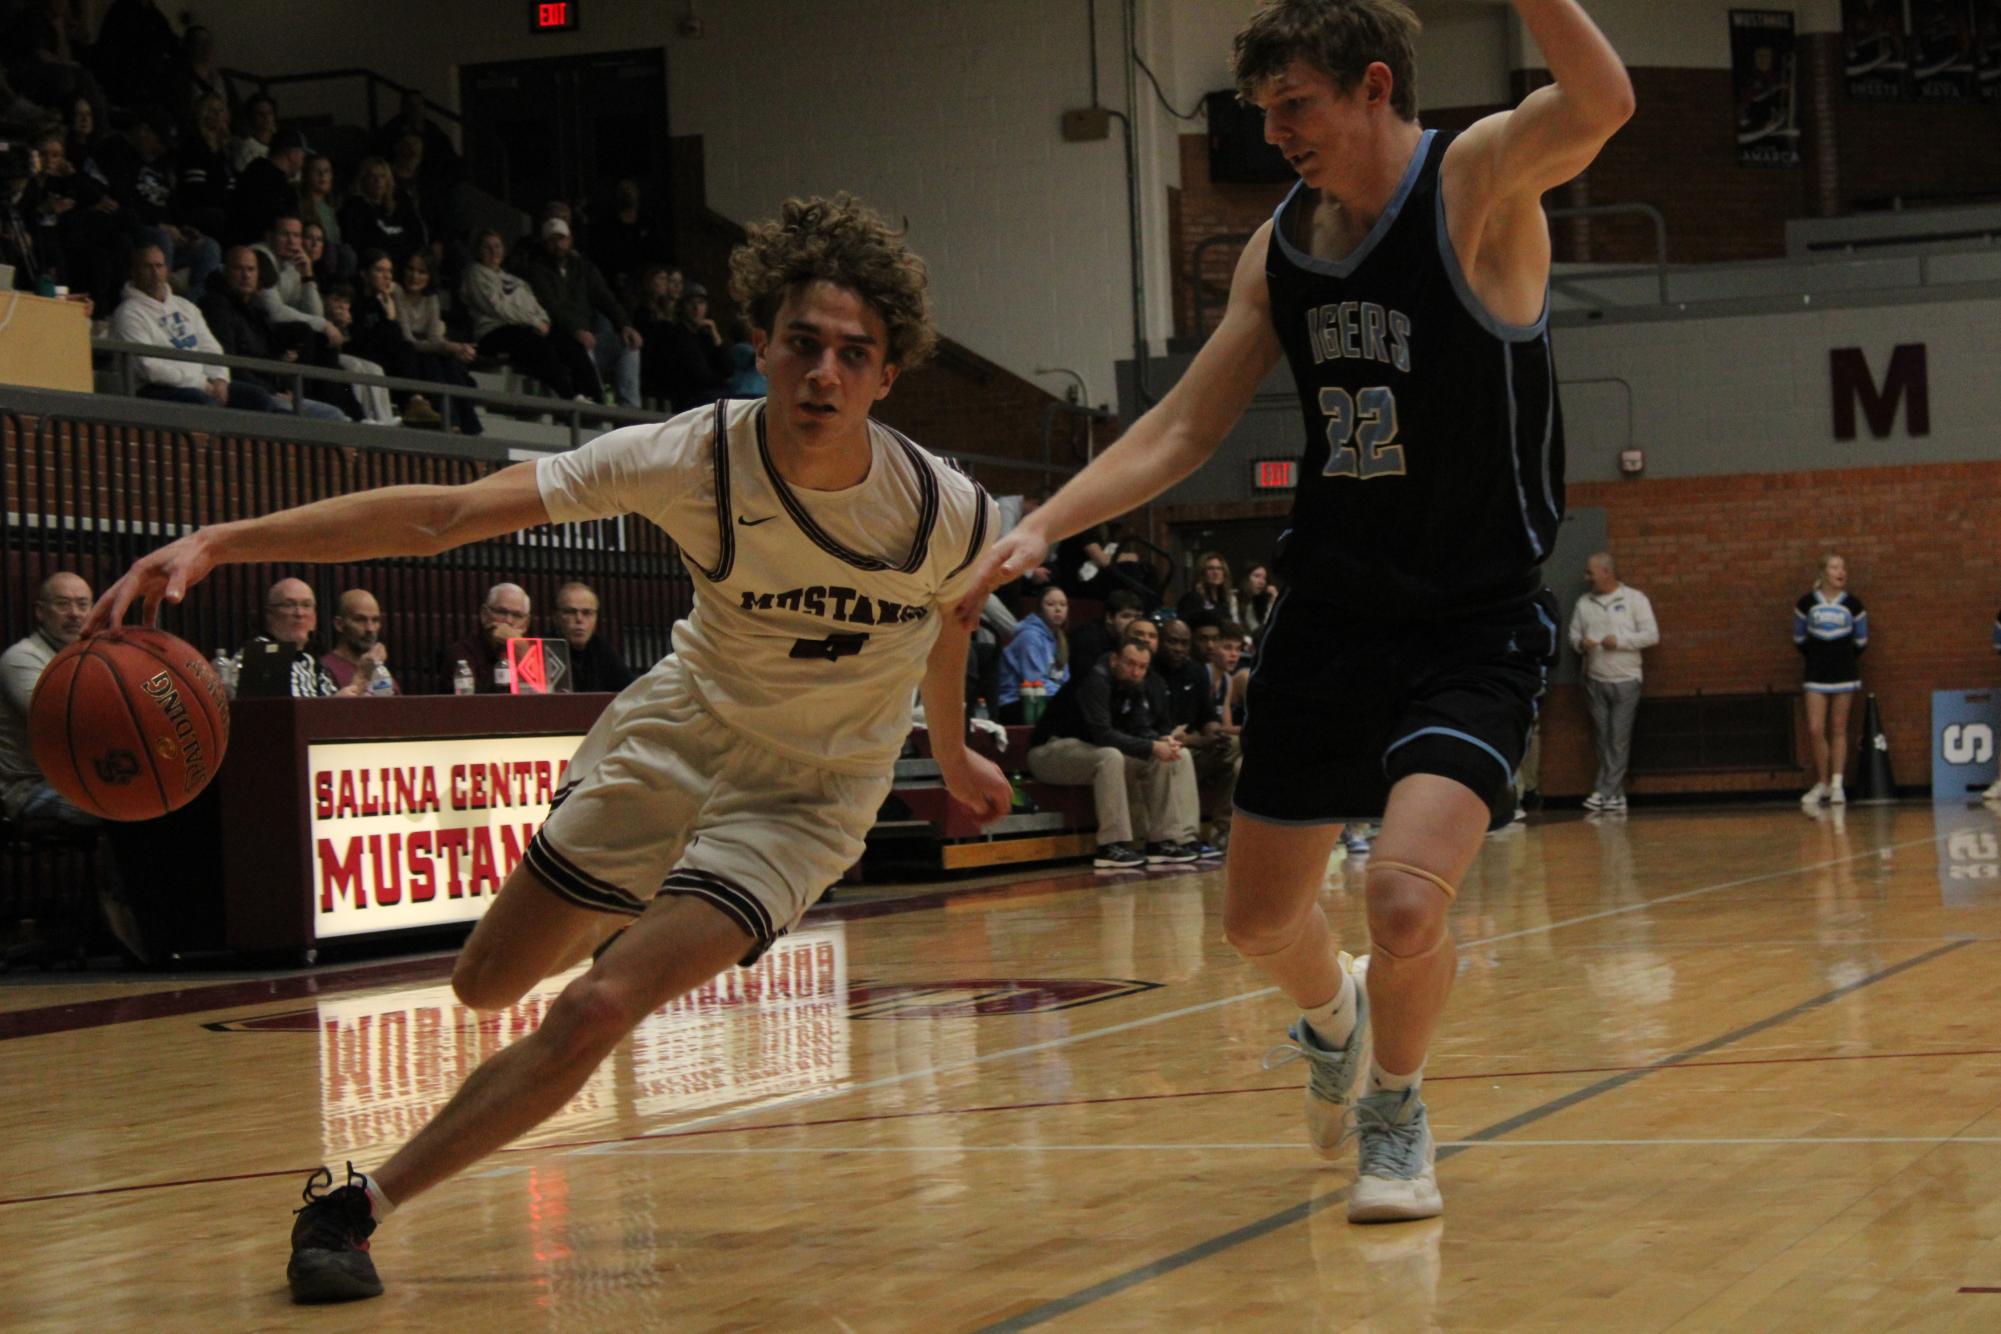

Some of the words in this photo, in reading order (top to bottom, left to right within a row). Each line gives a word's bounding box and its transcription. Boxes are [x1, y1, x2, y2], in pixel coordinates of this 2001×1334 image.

[539, 2, 566, 26] EXIT
[1305, 301, 1412, 373] IGERS
[1831, 344, 1928, 438] M
[1318, 386, 1408, 480] 22
[1262, 463, 1289, 487] EXIT
[141, 670, 208, 794] SPALDING
[316, 765, 441, 821] SALINA
